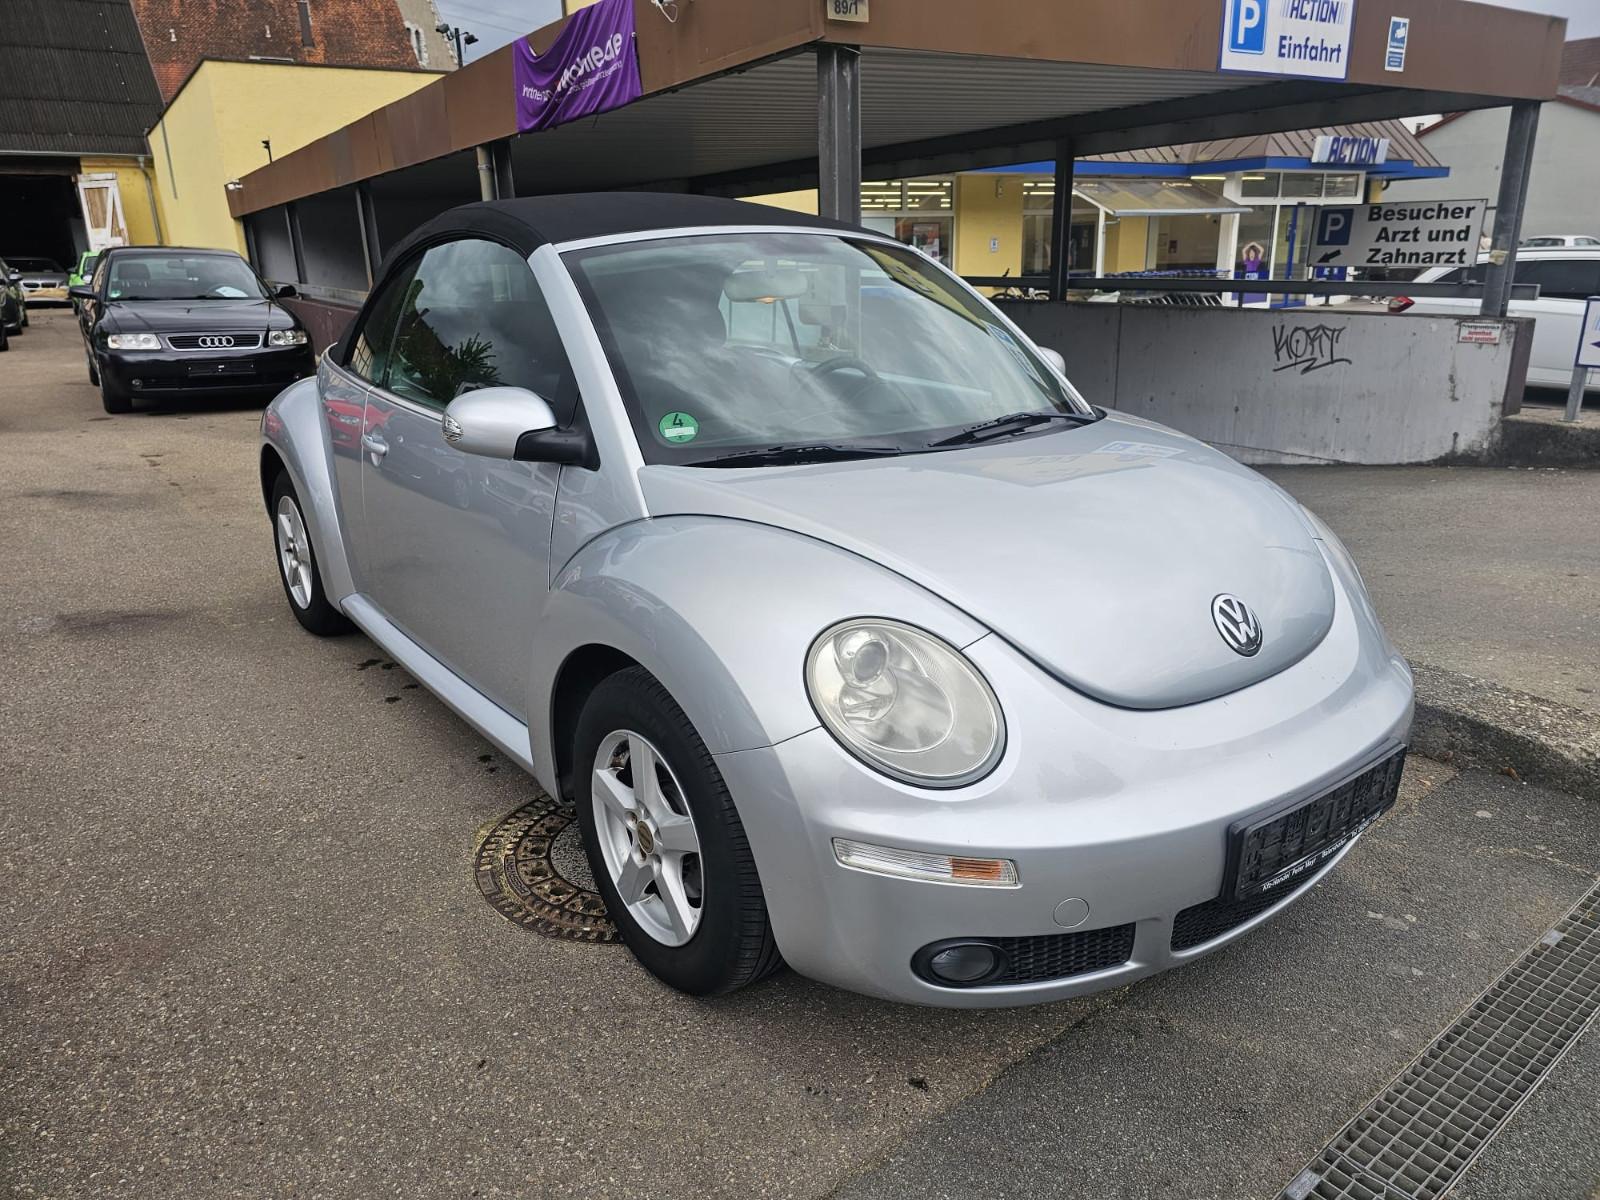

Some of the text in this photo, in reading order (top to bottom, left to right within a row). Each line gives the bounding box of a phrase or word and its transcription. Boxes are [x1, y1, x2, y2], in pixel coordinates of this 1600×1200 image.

[1237, 0, 1260, 44] P
[1289, 0, 1339, 24] ACTION
[1278, 35, 1342, 63] Einfahrt
[1328, 136, 1381, 164] ACTION
[1368, 203, 1475, 221] Besucher
[1324, 213, 1345, 241] P
[1375, 225, 1471, 242] Arzt und
[1366, 247, 1466, 264] Zahnarzt
[673, 413, 683, 426] 4
